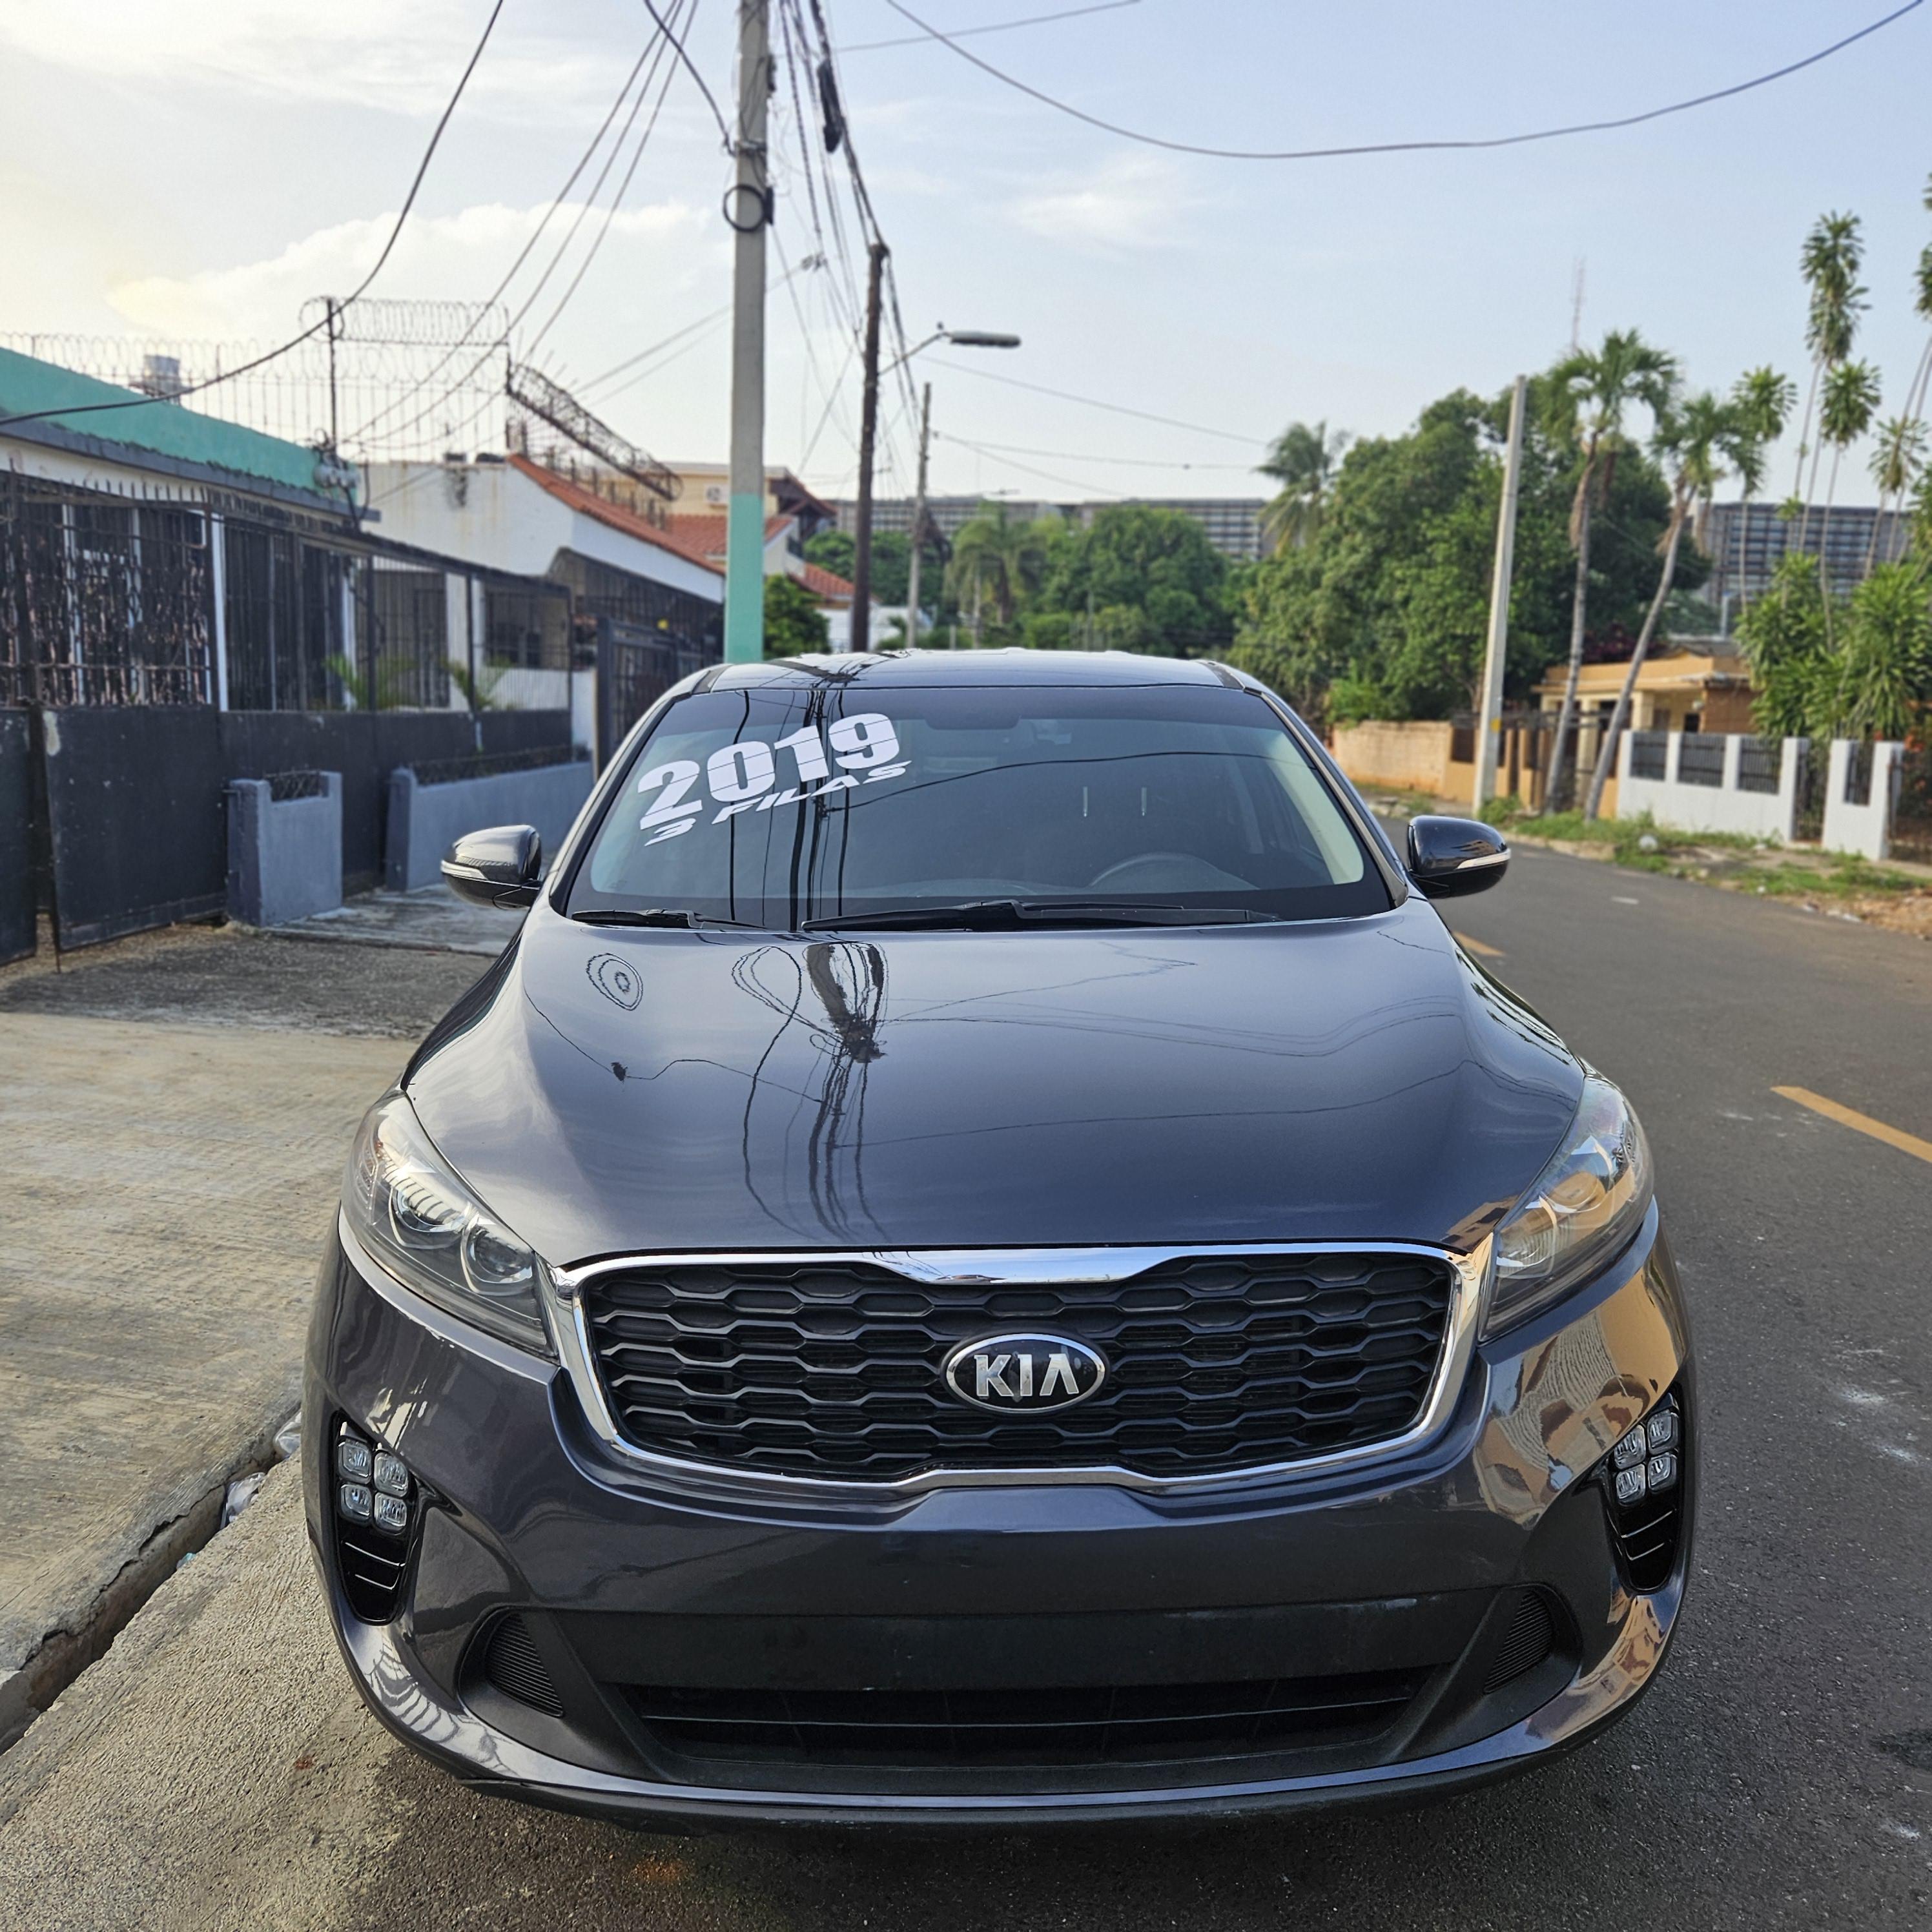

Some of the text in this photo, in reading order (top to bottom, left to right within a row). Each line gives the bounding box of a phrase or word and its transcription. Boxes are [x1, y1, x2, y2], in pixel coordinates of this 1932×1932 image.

[638, 713, 899, 830] 2019
[644, 761, 912, 846] 3 FILAS
[974, 1354, 1079, 1396] KIA
